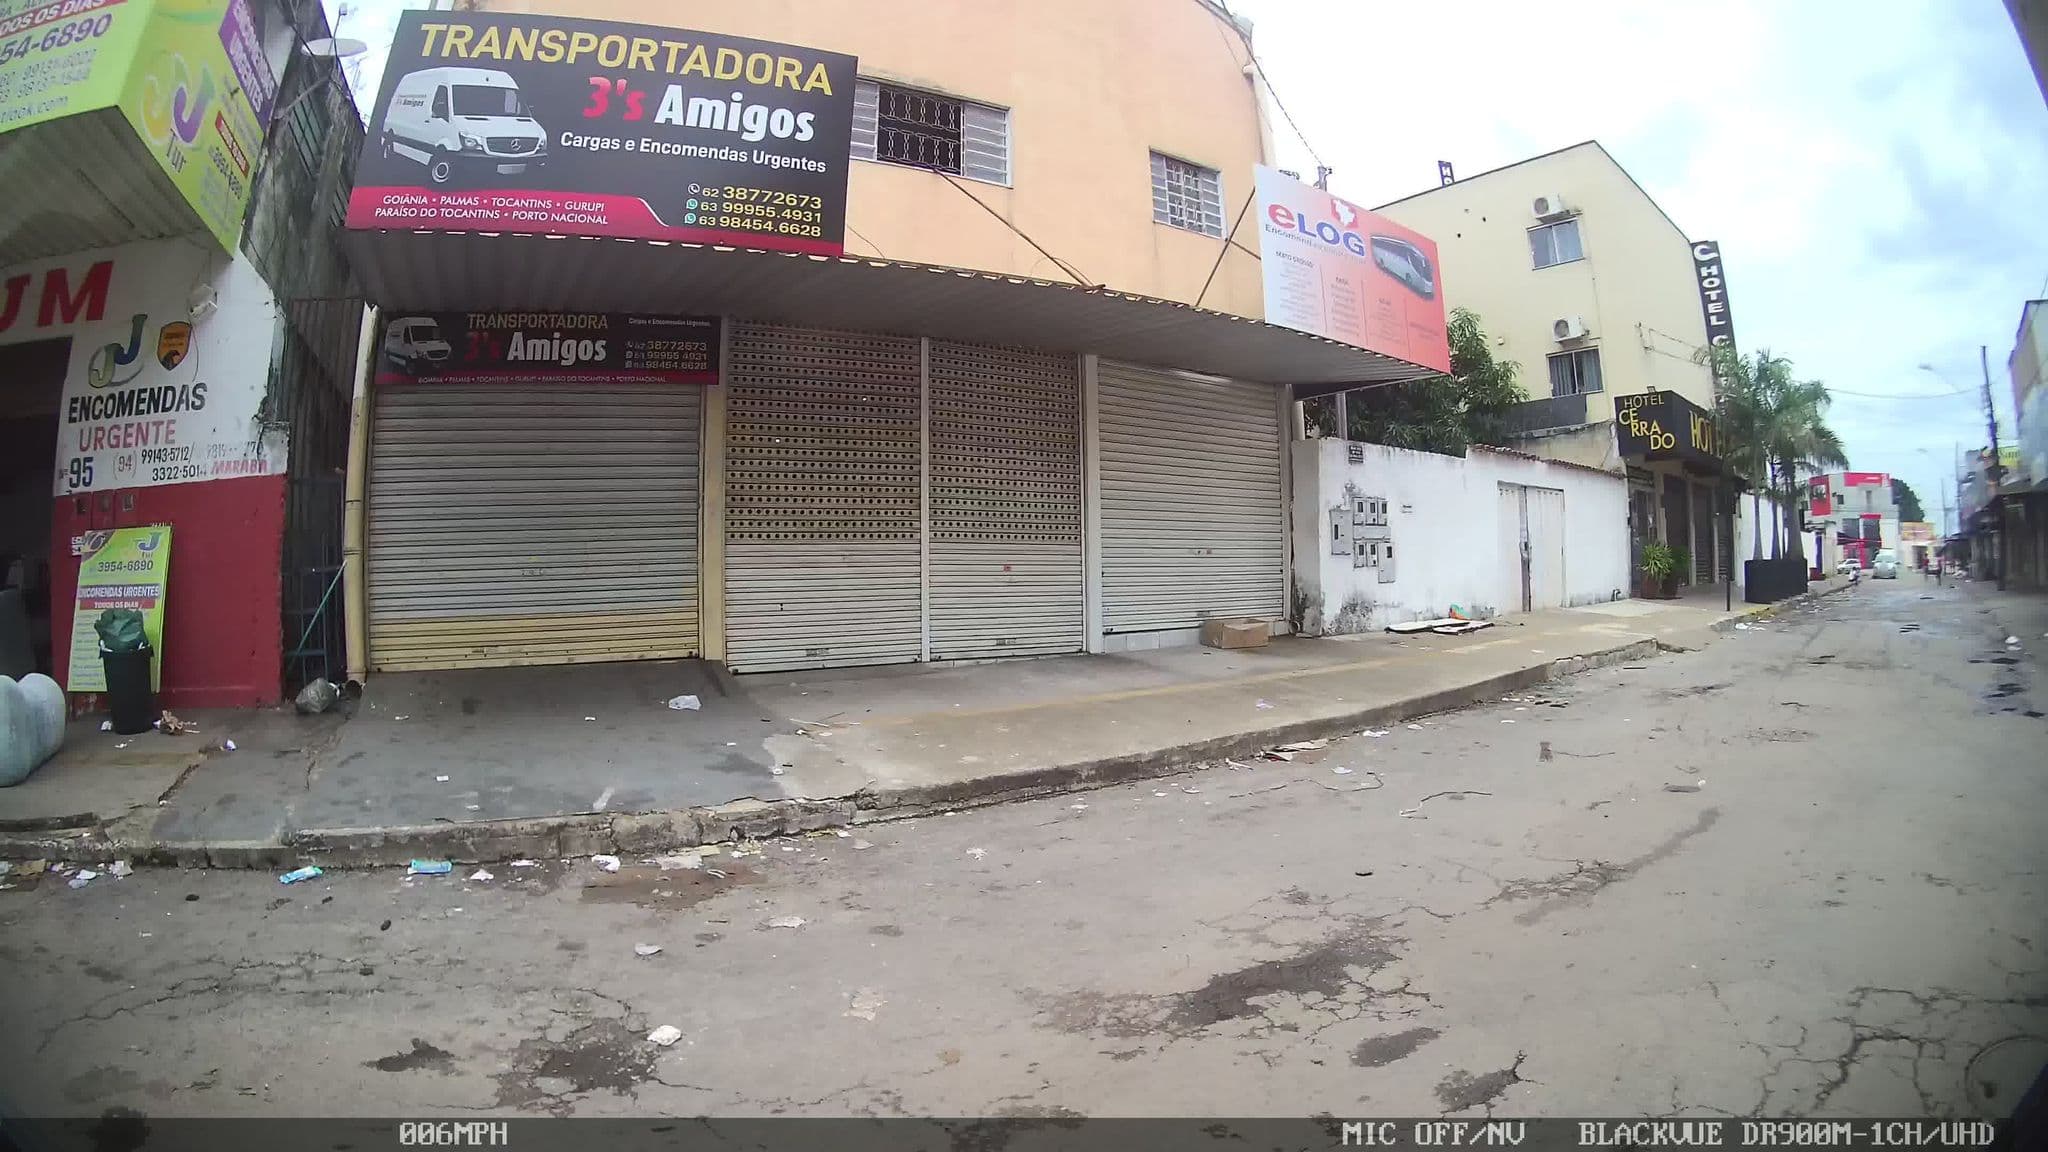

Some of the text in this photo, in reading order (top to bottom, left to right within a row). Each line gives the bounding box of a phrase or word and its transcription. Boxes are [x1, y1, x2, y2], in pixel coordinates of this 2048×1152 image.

[420, 23, 833, 95] TRANSPORTADORA
[582, 77, 815, 142] 3's Amigos
[560, 131, 827, 174] Cargas e Encomendas Urgentes
[383, 193, 605, 212] GOIÂNIA PALMAS TOCANTINS GURUPI
[702, 186, 822, 209] 62 38772673
[375, 206, 608, 225] PARAÍSO DO TOCANTINS PORTO NACIONAL
[700, 201, 822, 224] 63 99955.4931
[699, 216, 822, 238] 63 98454.6628
[1700, 265, 1727, 327] HOTEL
[467, 313, 609, 329] TRANSPORTADORA
[507, 331, 607, 366] Amigos
[646, 340, 707, 351] 38772673
[68, 382, 208, 424] ENCOMENDAS
[1624, 394, 1665, 408] HOTEL
[1619, 407, 1639, 425] CE
[79, 418, 177, 452] URGENTE
[1631, 420, 1662, 437] RRA
[1650, 433, 1675, 450] DO
[69, 456, 94, 489] 95
[97, 560, 154, 573] 3954-6890
[78, 585, 160, 599] ENCOMENDAS URGENTES
